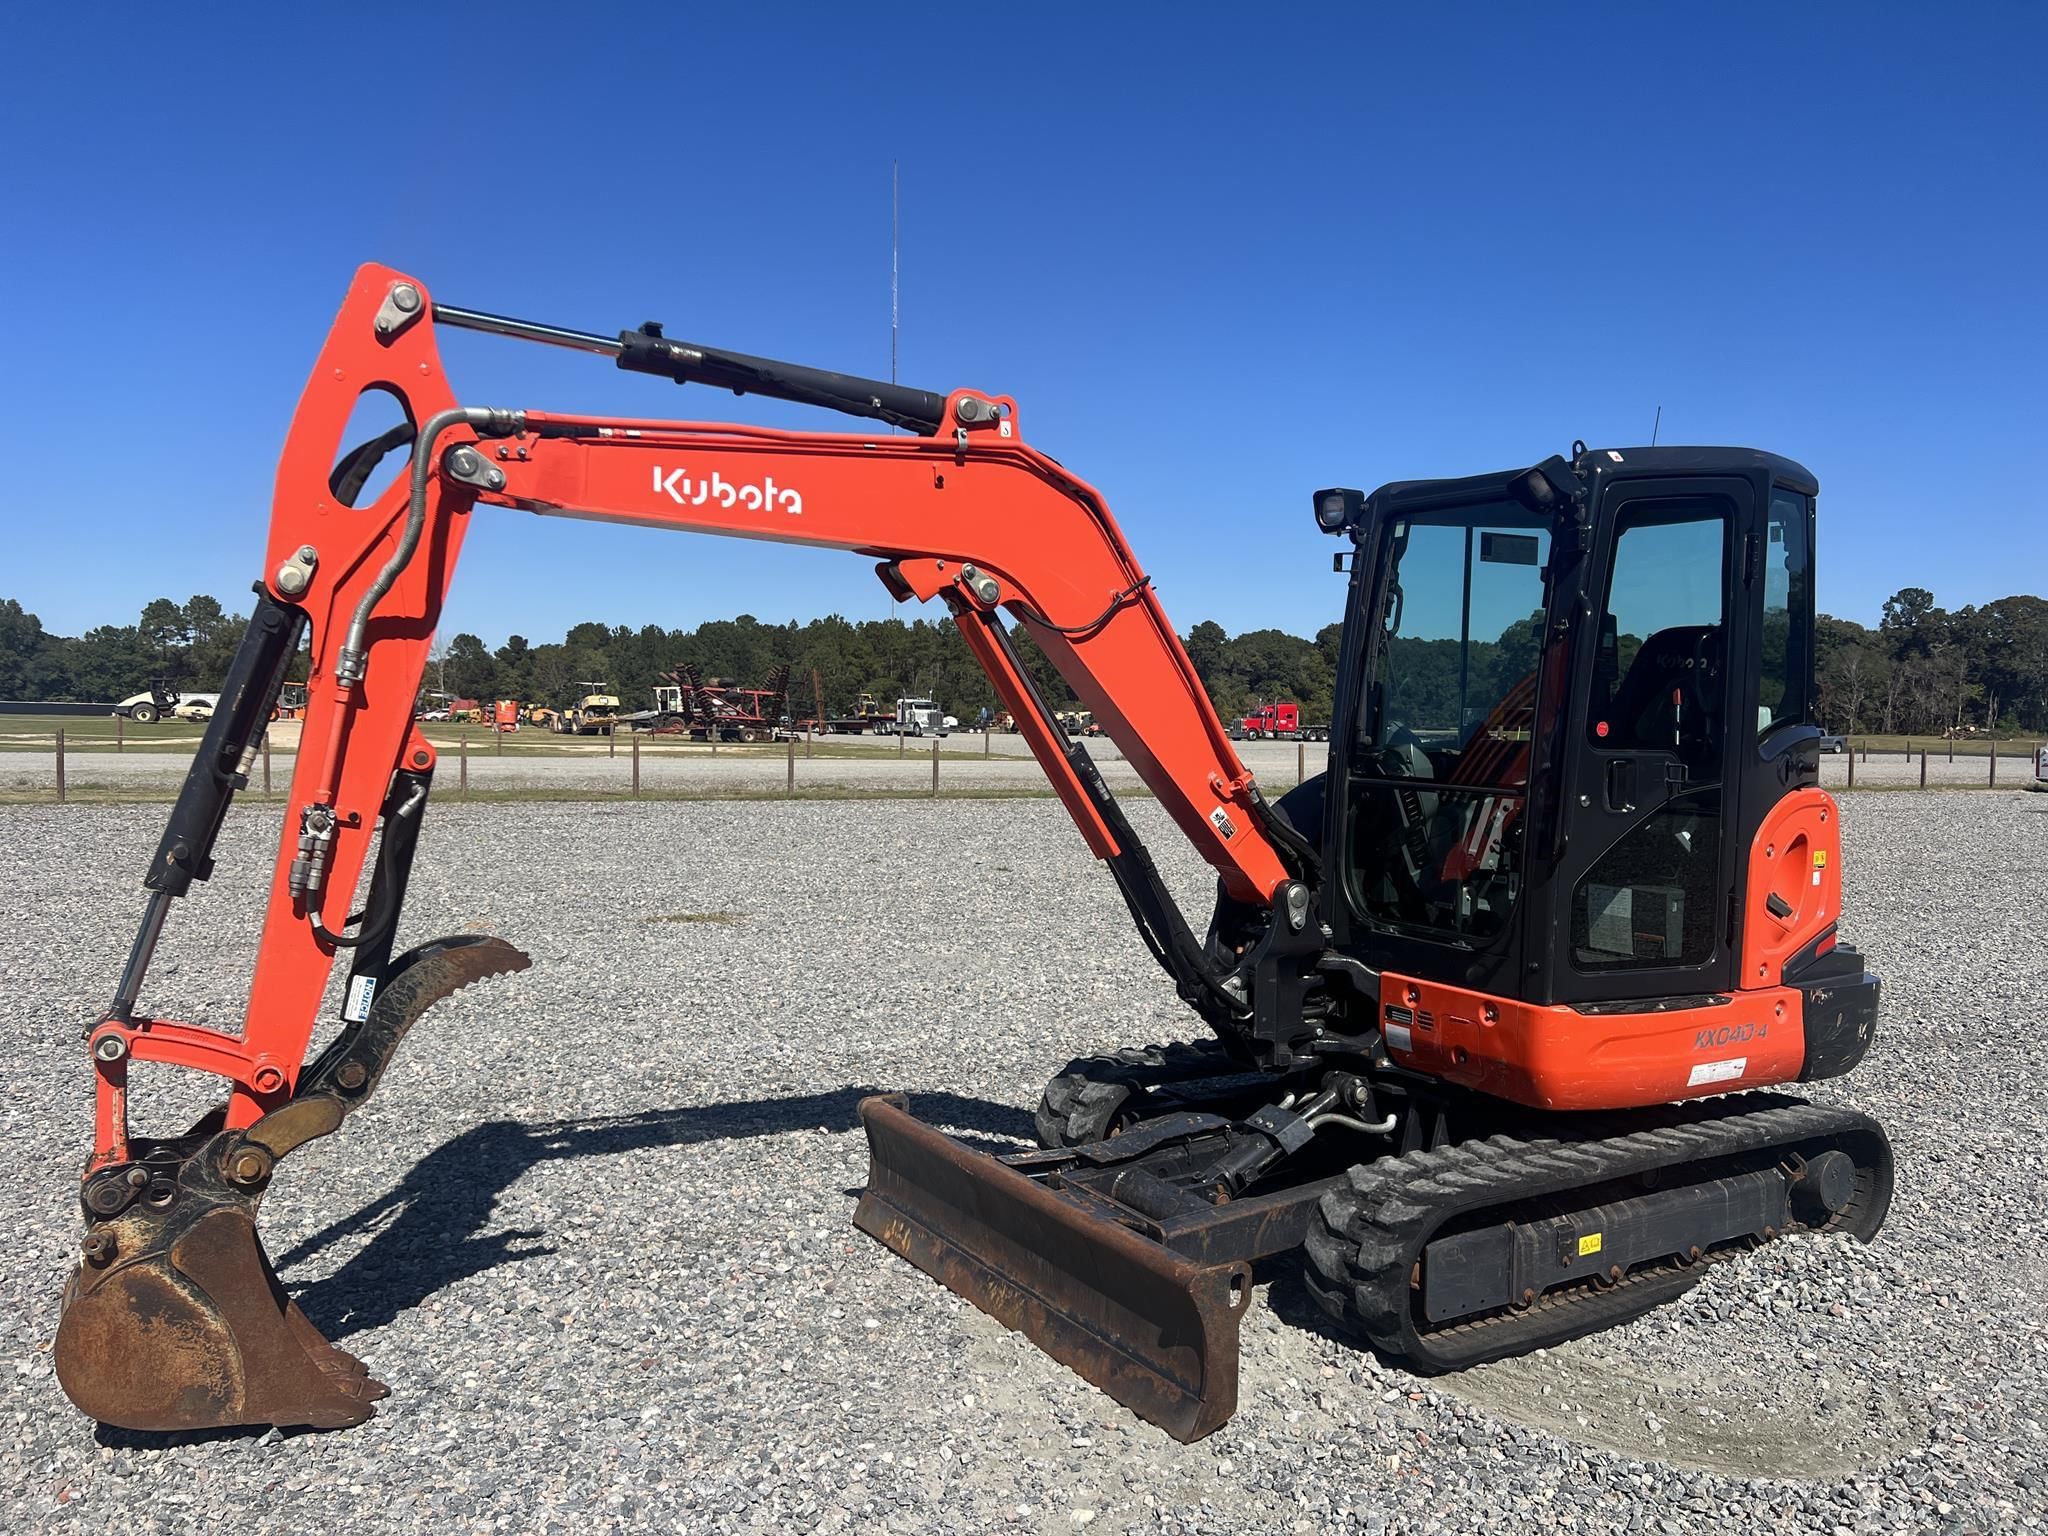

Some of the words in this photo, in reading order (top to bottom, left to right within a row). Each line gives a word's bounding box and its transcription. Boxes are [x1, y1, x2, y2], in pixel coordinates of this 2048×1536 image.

[653, 465, 802, 515] Kubota
[1656, 652, 1708, 670] Kuboa
[358, 982, 375, 1018] NOTICE
[1695, 1023, 1768, 1049] KX040-4
